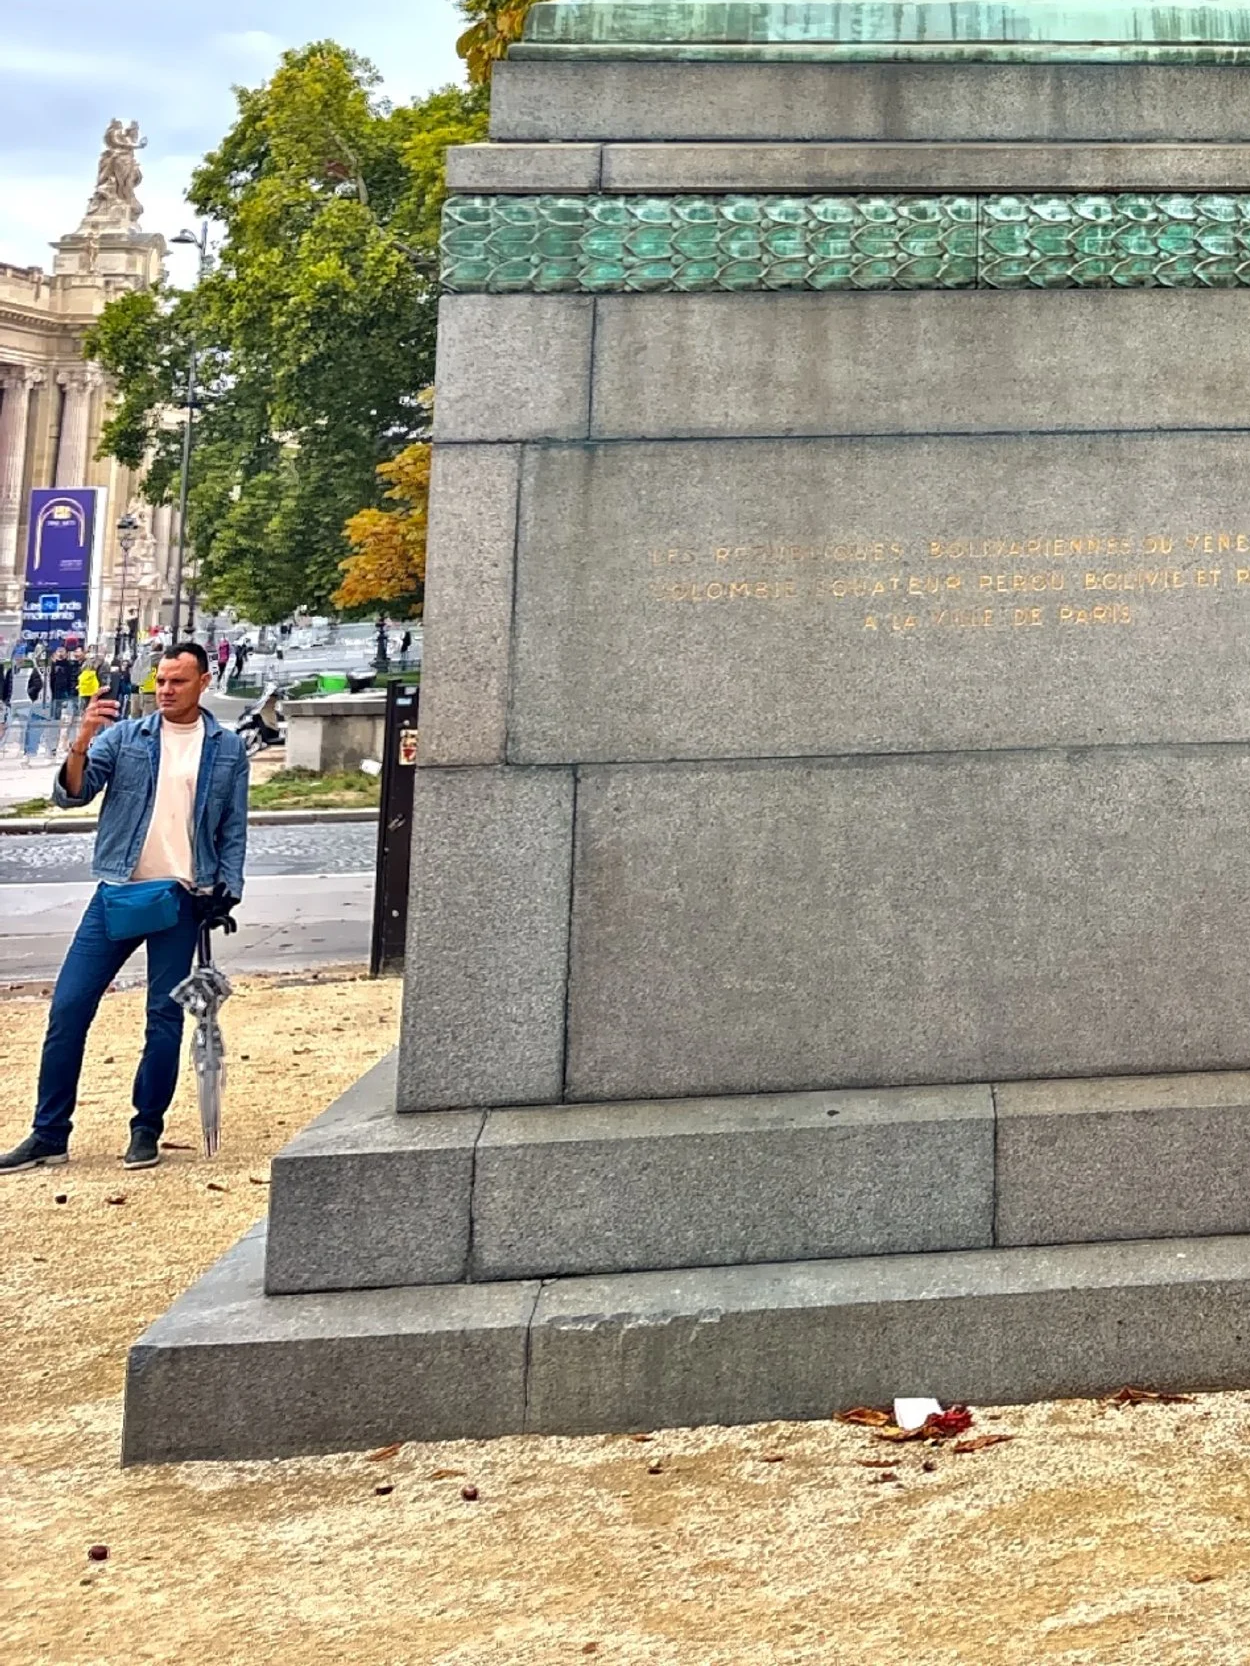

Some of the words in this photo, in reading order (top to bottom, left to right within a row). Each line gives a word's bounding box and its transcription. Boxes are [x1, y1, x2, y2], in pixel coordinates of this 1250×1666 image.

[1143, 536, 1173, 554] DU
[1084, 569, 1185, 591] BOLIVIE
[1196, 569, 1222, 587] ET
[891, 614, 919, 632] LA
[1014, 607, 1043, 627] DE
[1060, 603, 1132, 625] PARIS
